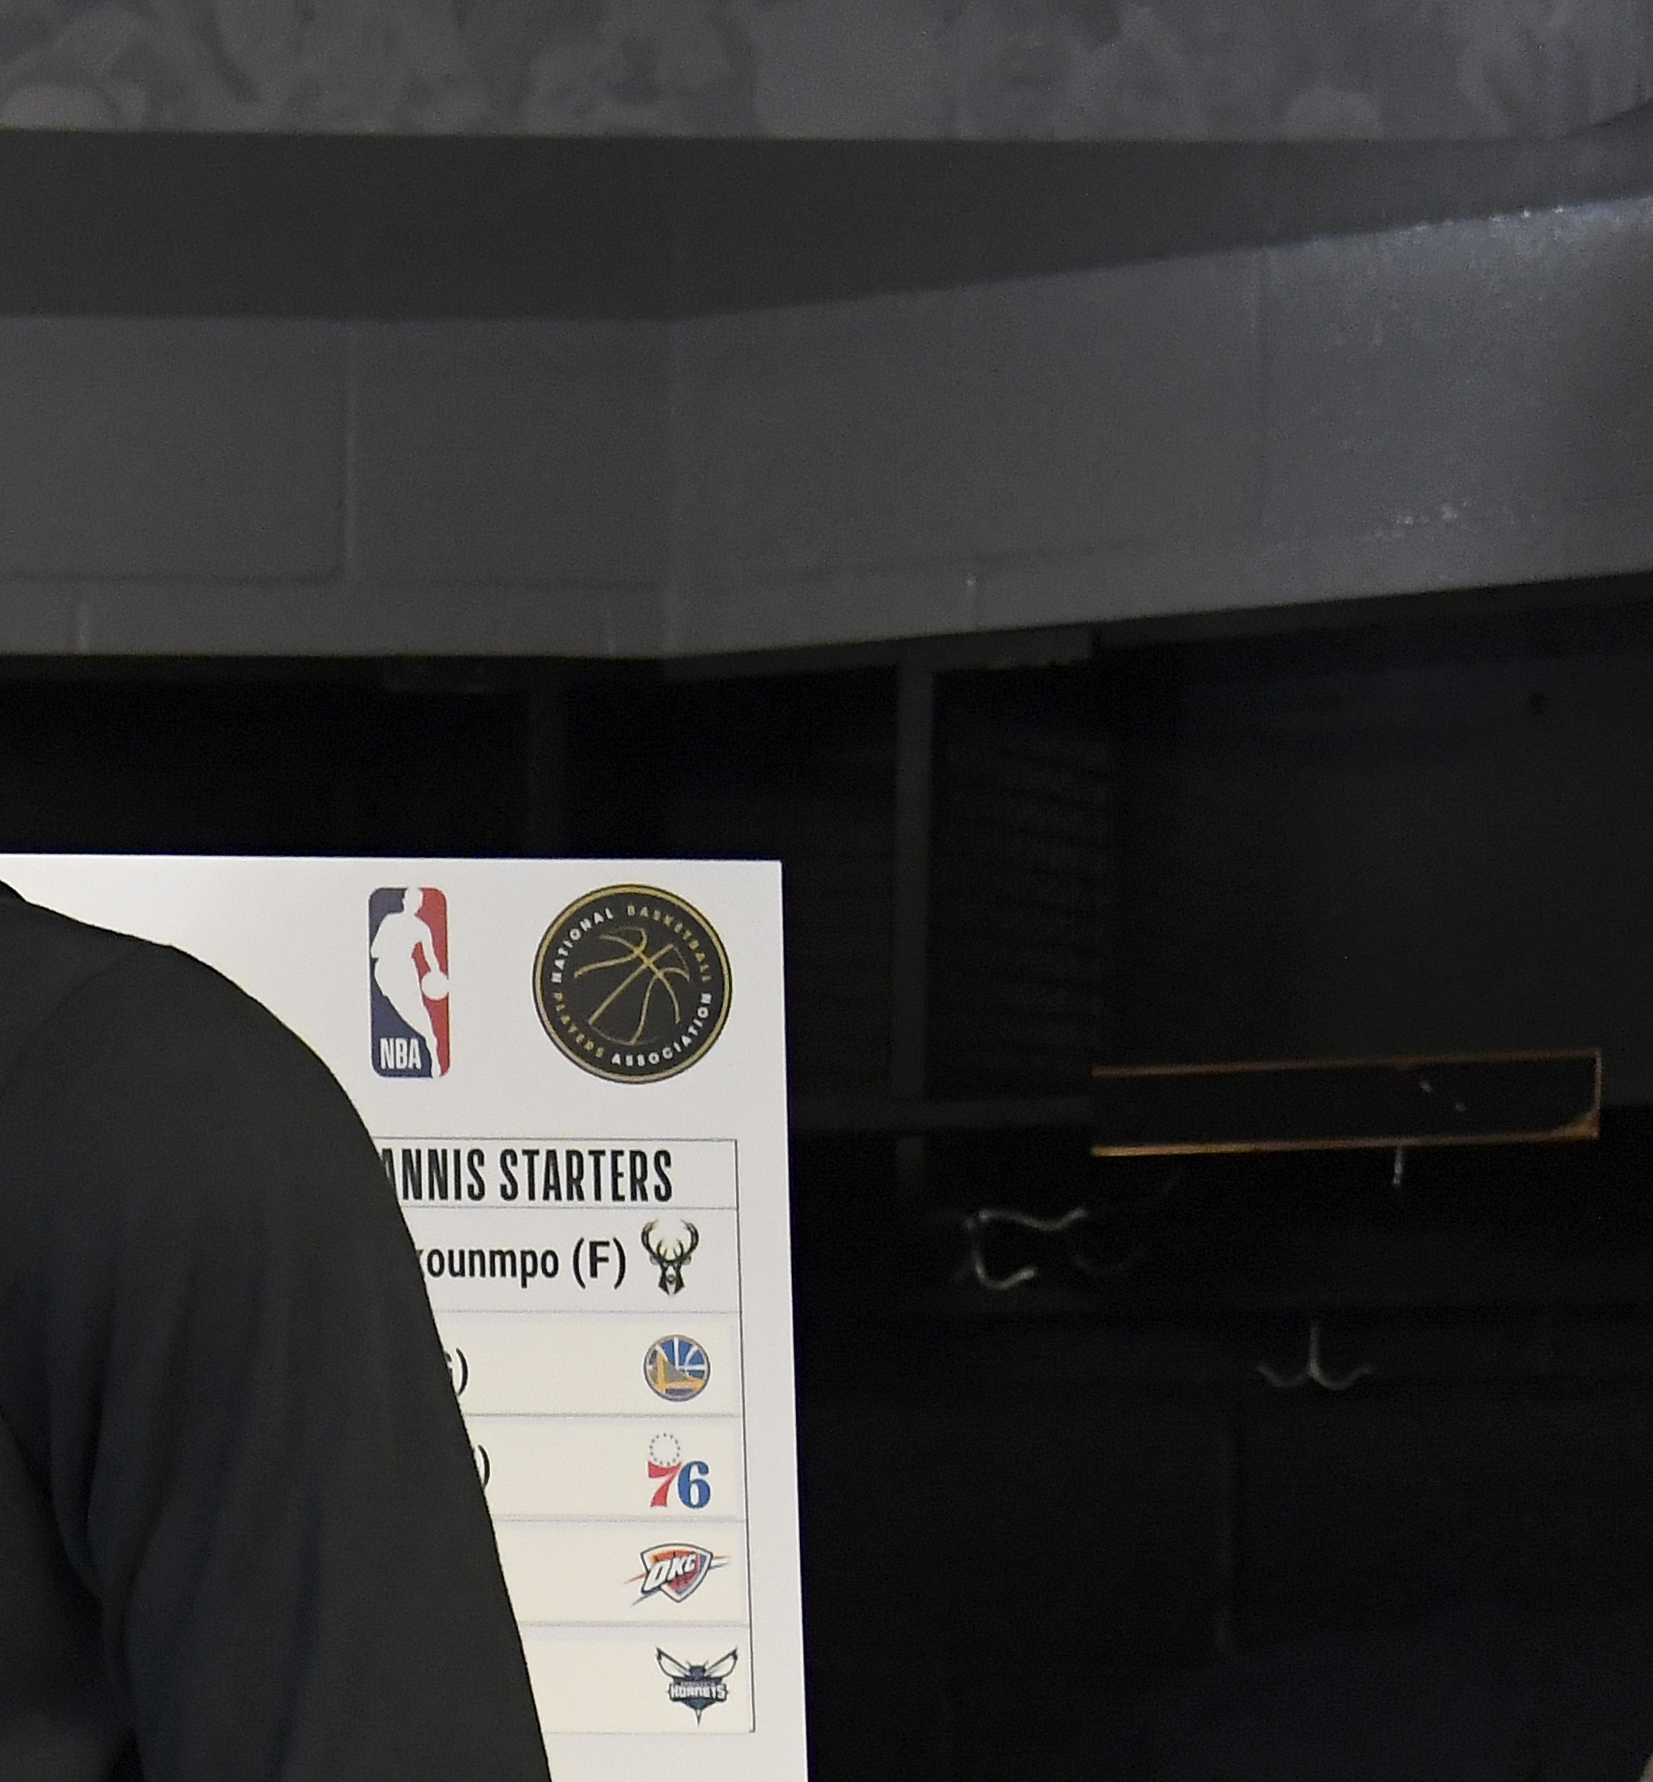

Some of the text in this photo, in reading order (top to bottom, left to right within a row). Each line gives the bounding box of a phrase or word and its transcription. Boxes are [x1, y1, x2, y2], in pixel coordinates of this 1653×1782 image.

[379, 1037, 422, 1070] NBA
[499, 1148, 673, 1203] STARTERS
[417, 1237, 626, 1290] ounmpo (F)
[647, 1460, 711, 1509] 76
[643, 1553, 697, 1592] OKC
